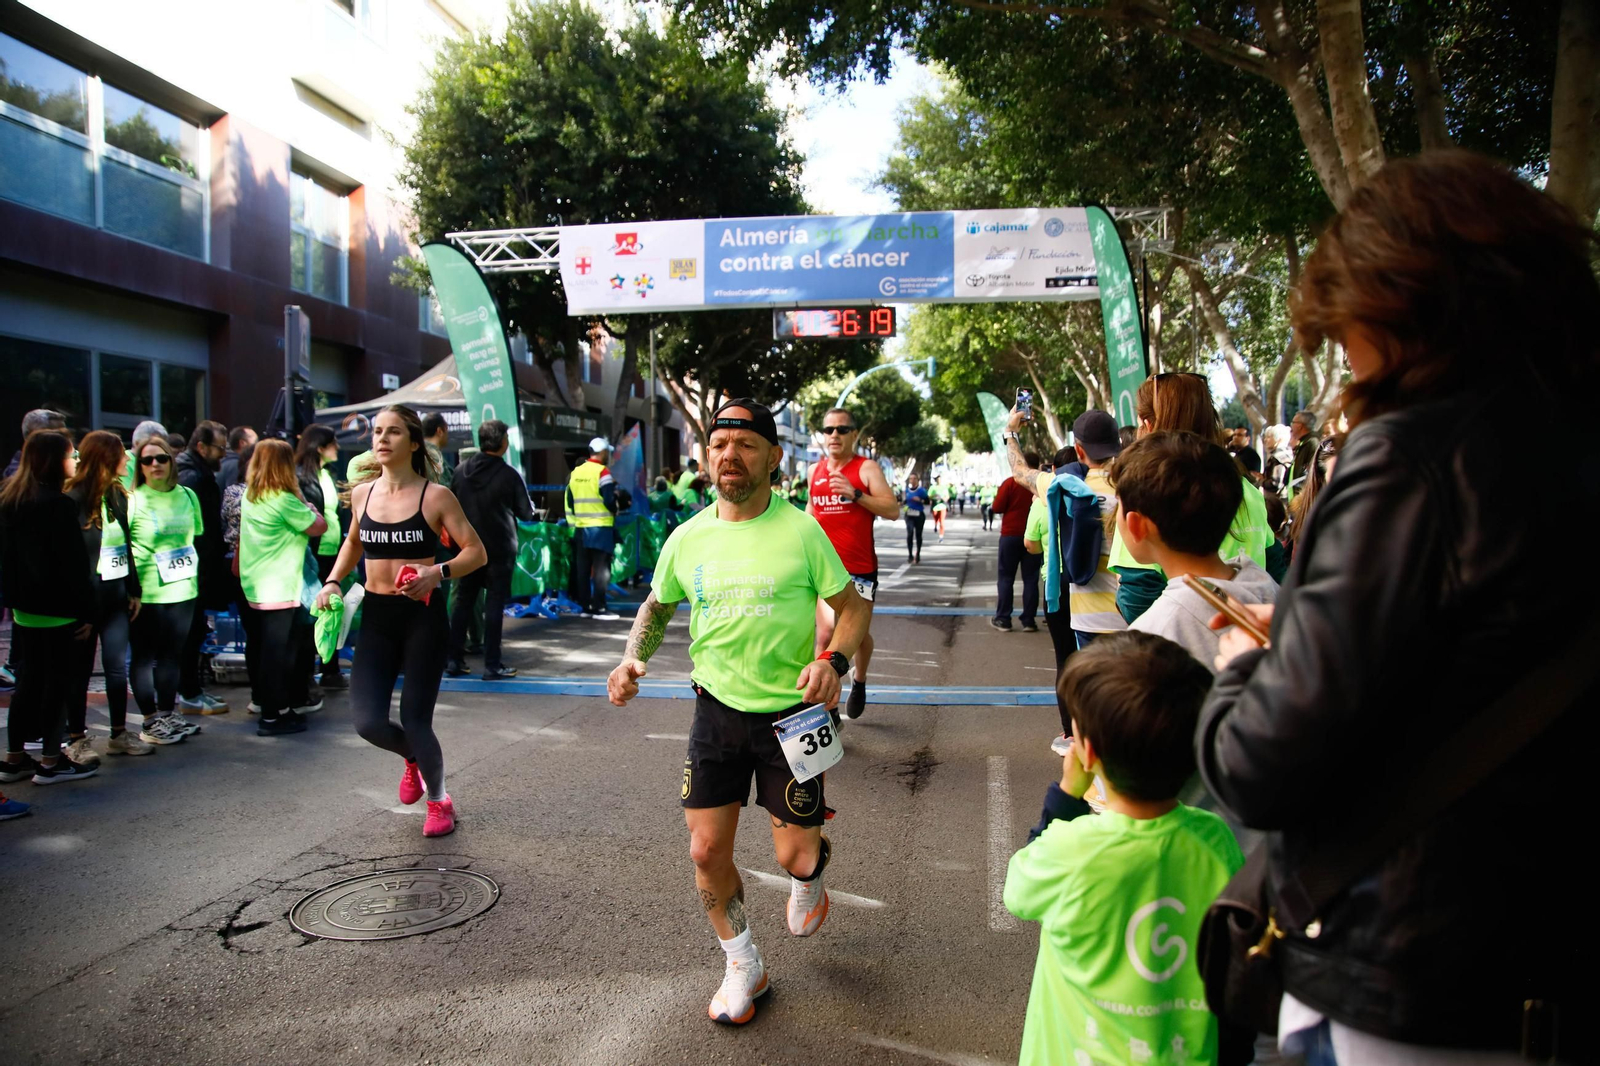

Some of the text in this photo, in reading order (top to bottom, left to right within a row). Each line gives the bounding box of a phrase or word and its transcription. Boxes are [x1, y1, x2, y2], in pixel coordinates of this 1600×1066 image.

[720, 221, 940, 247] Almería en marcha
[983, 222, 1031, 235] cajamar
[720, 248, 910, 273] contra el cáncer
[1027, 247, 1083, 260] Fundación
[359, 529, 424, 543] CALVIN KLEIN
[168, 556, 193, 570] 493
[704, 573, 776, 589] En marcha
[692, 564, 709, 619] ALMERÍA
[707, 585, 775, 601] contra el
[709, 601, 776, 619] cáncer
[807, 713, 826, 725] cáncer
[799, 720, 838, 756] 38
